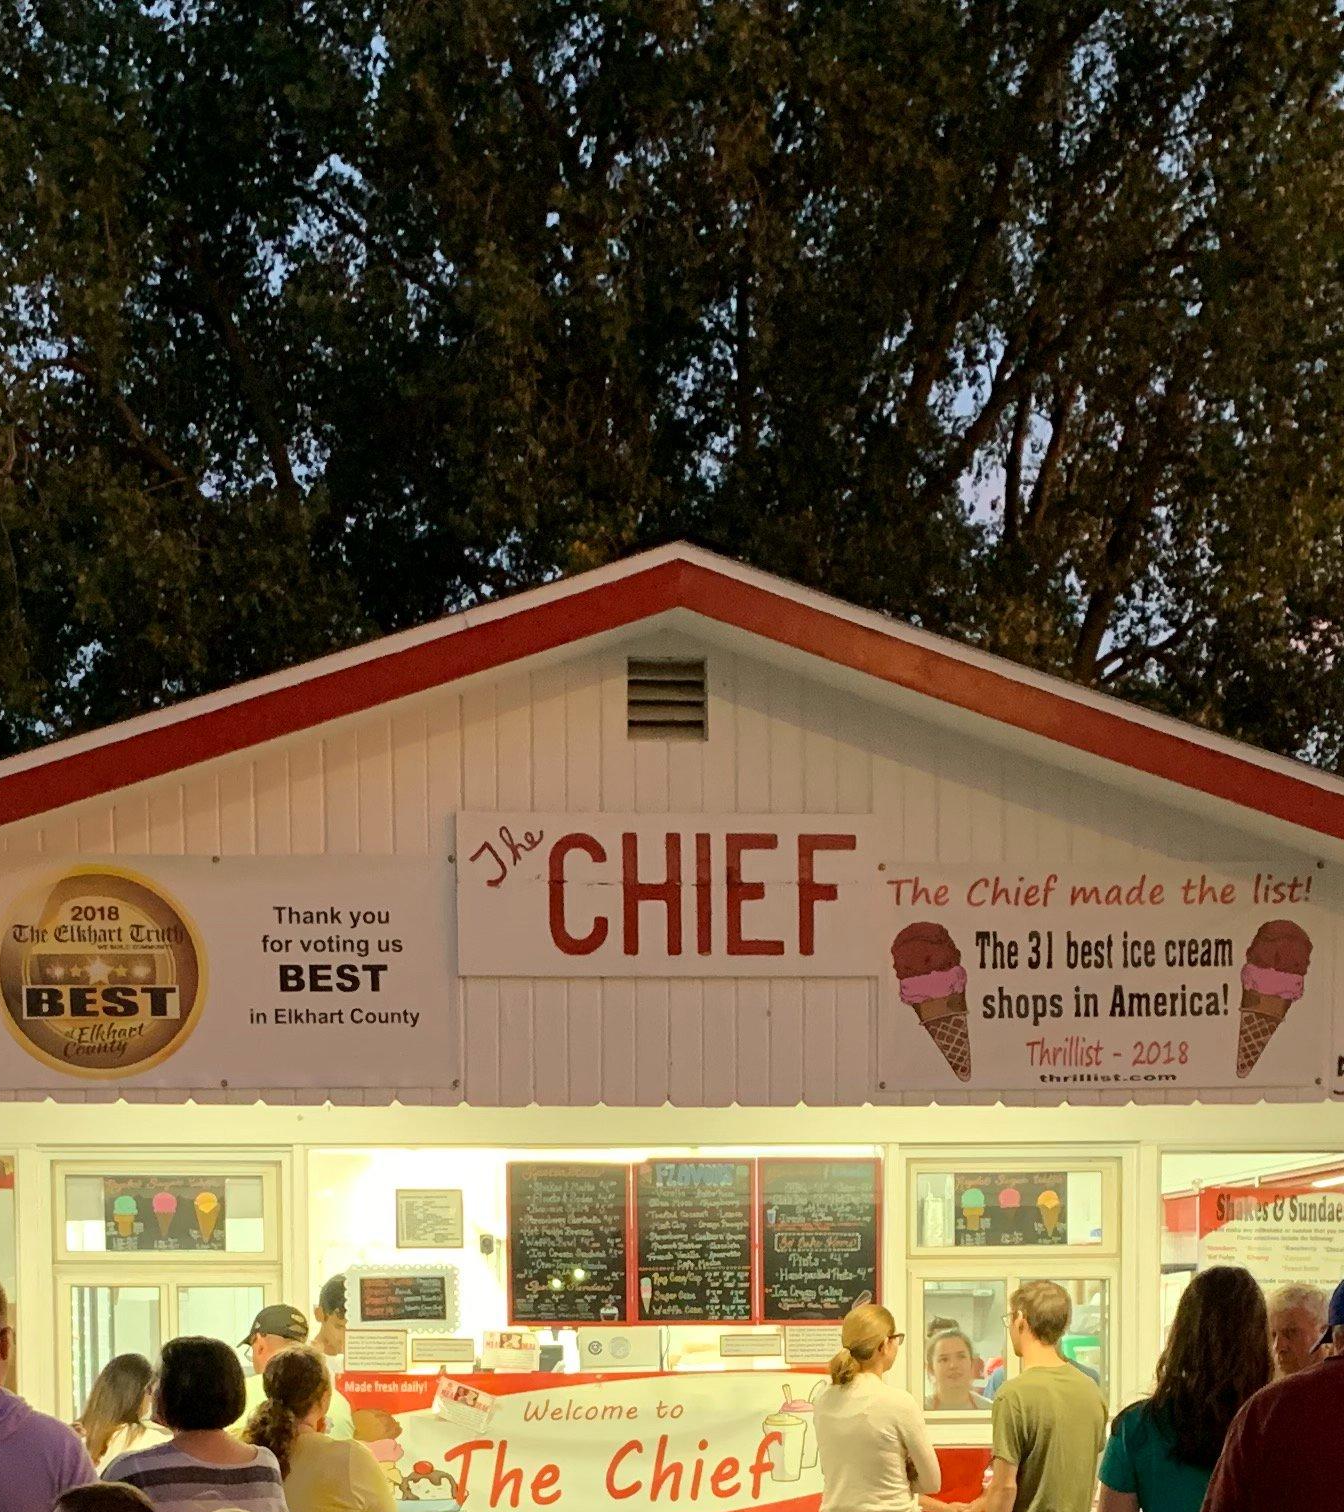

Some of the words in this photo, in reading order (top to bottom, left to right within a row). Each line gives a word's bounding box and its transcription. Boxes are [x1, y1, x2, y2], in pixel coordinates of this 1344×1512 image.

[469, 825, 544, 888] The
[548, 832, 857, 956] CHIEF
[886, 876, 950, 906] The
[966, 874, 1058, 907] Chief
[1071, 874, 1165, 906] made
[1181, 874, 1236, 904] the
[1253, 874, 1312, 904] list!
[71, 906, 119, 921] 2018
[273, 906, 342, 924] Thank
[349, 910, 390, 928] you
[13, 925, 48, 944] The
[54, 925, 122, 944] Elkhart
[130, 924, 183, 943] Truth
[262, 934, 292, 953] for
[299, 934, 369, 957] voting
[377, 938, 403, 952] us
[975, 931, 1018, 969] The
[1027, 931, 1053, 969] 31
[1066, 931, 1114, 969] best
[1122, 931, 1156, 968] ice
[1165, 937, 1233, 968] cream
[279, 964, 388, 992] BEST
[26, 987, 176, 1017] BEST
[982, 986, 1063, 1027] shops
[1074, 985, 1099, 1017] in
[1109, 983, 1229, 1017] America!
[249, 1008, 267, 1024] in
[274, 1008, 344, 1024] Elkhart
[350, 1008, 420, 1027] County
[77, 1023, 144, 1044] Elkhart
[63, 1041, 127, 1057] County
[1026, 1037, 1103, 1067] Thrillist
[1132, 1040, 1189, 1067] 2018
[1040, 1074, 1177, 1083] thrillist.com
[1216, 1194, 1268, 1222] Shakes
[1273, 1194, 1285, 1222] &
[344, 1382, 372, 1392] Made
[374, 1381, 399, 1392] fresh
[401, 1381, 428, 1395] daily!
[523, 1399, 638, 1422] Welcome
[656, 1400, 684, 1420] to
[444, 1439, 562, 1509] The
[605, 1431, 783, 1502] Chief
